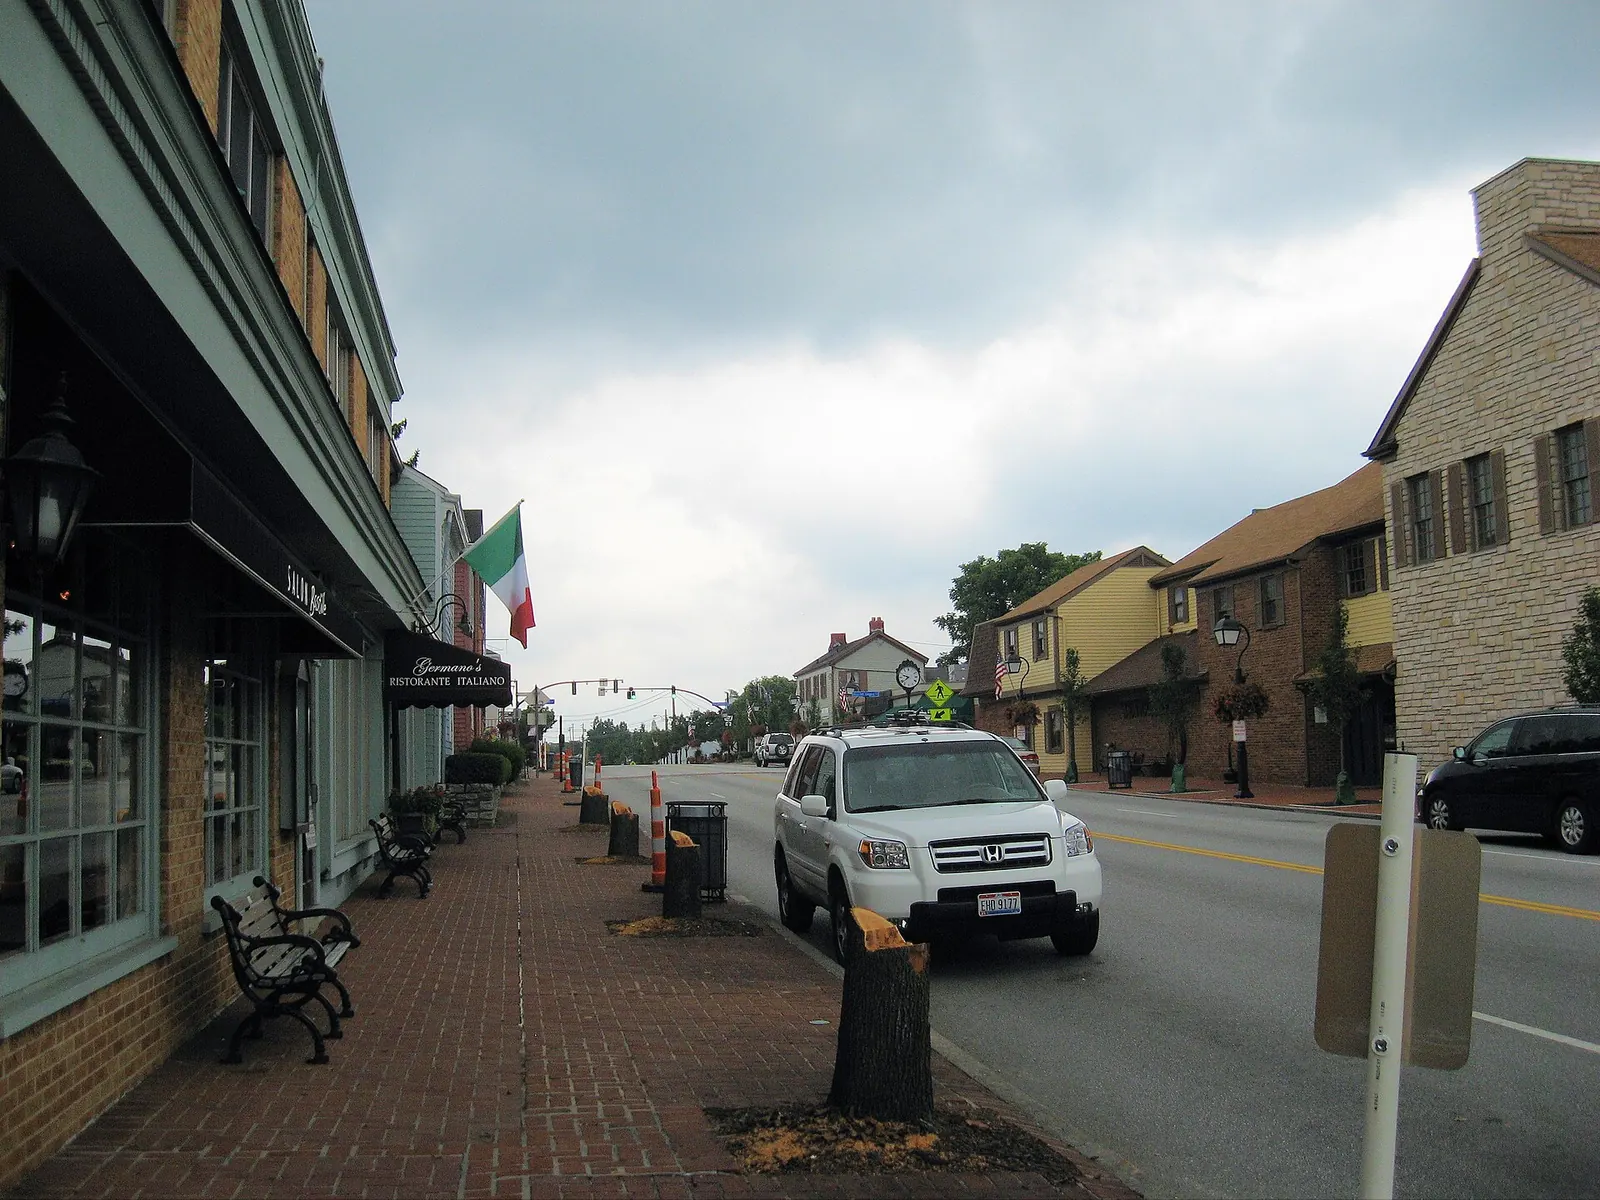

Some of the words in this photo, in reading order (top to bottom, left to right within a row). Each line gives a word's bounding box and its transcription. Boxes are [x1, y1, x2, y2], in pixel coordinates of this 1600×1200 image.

[287, 564, 308, 606] SALON
[412, 656, 483, 677] Germano's
[389, 676, 451, 687] RISTORANTE
[457, 676, 505, 686] ITALIANO
[998, 897, 1018, 910] 9177
